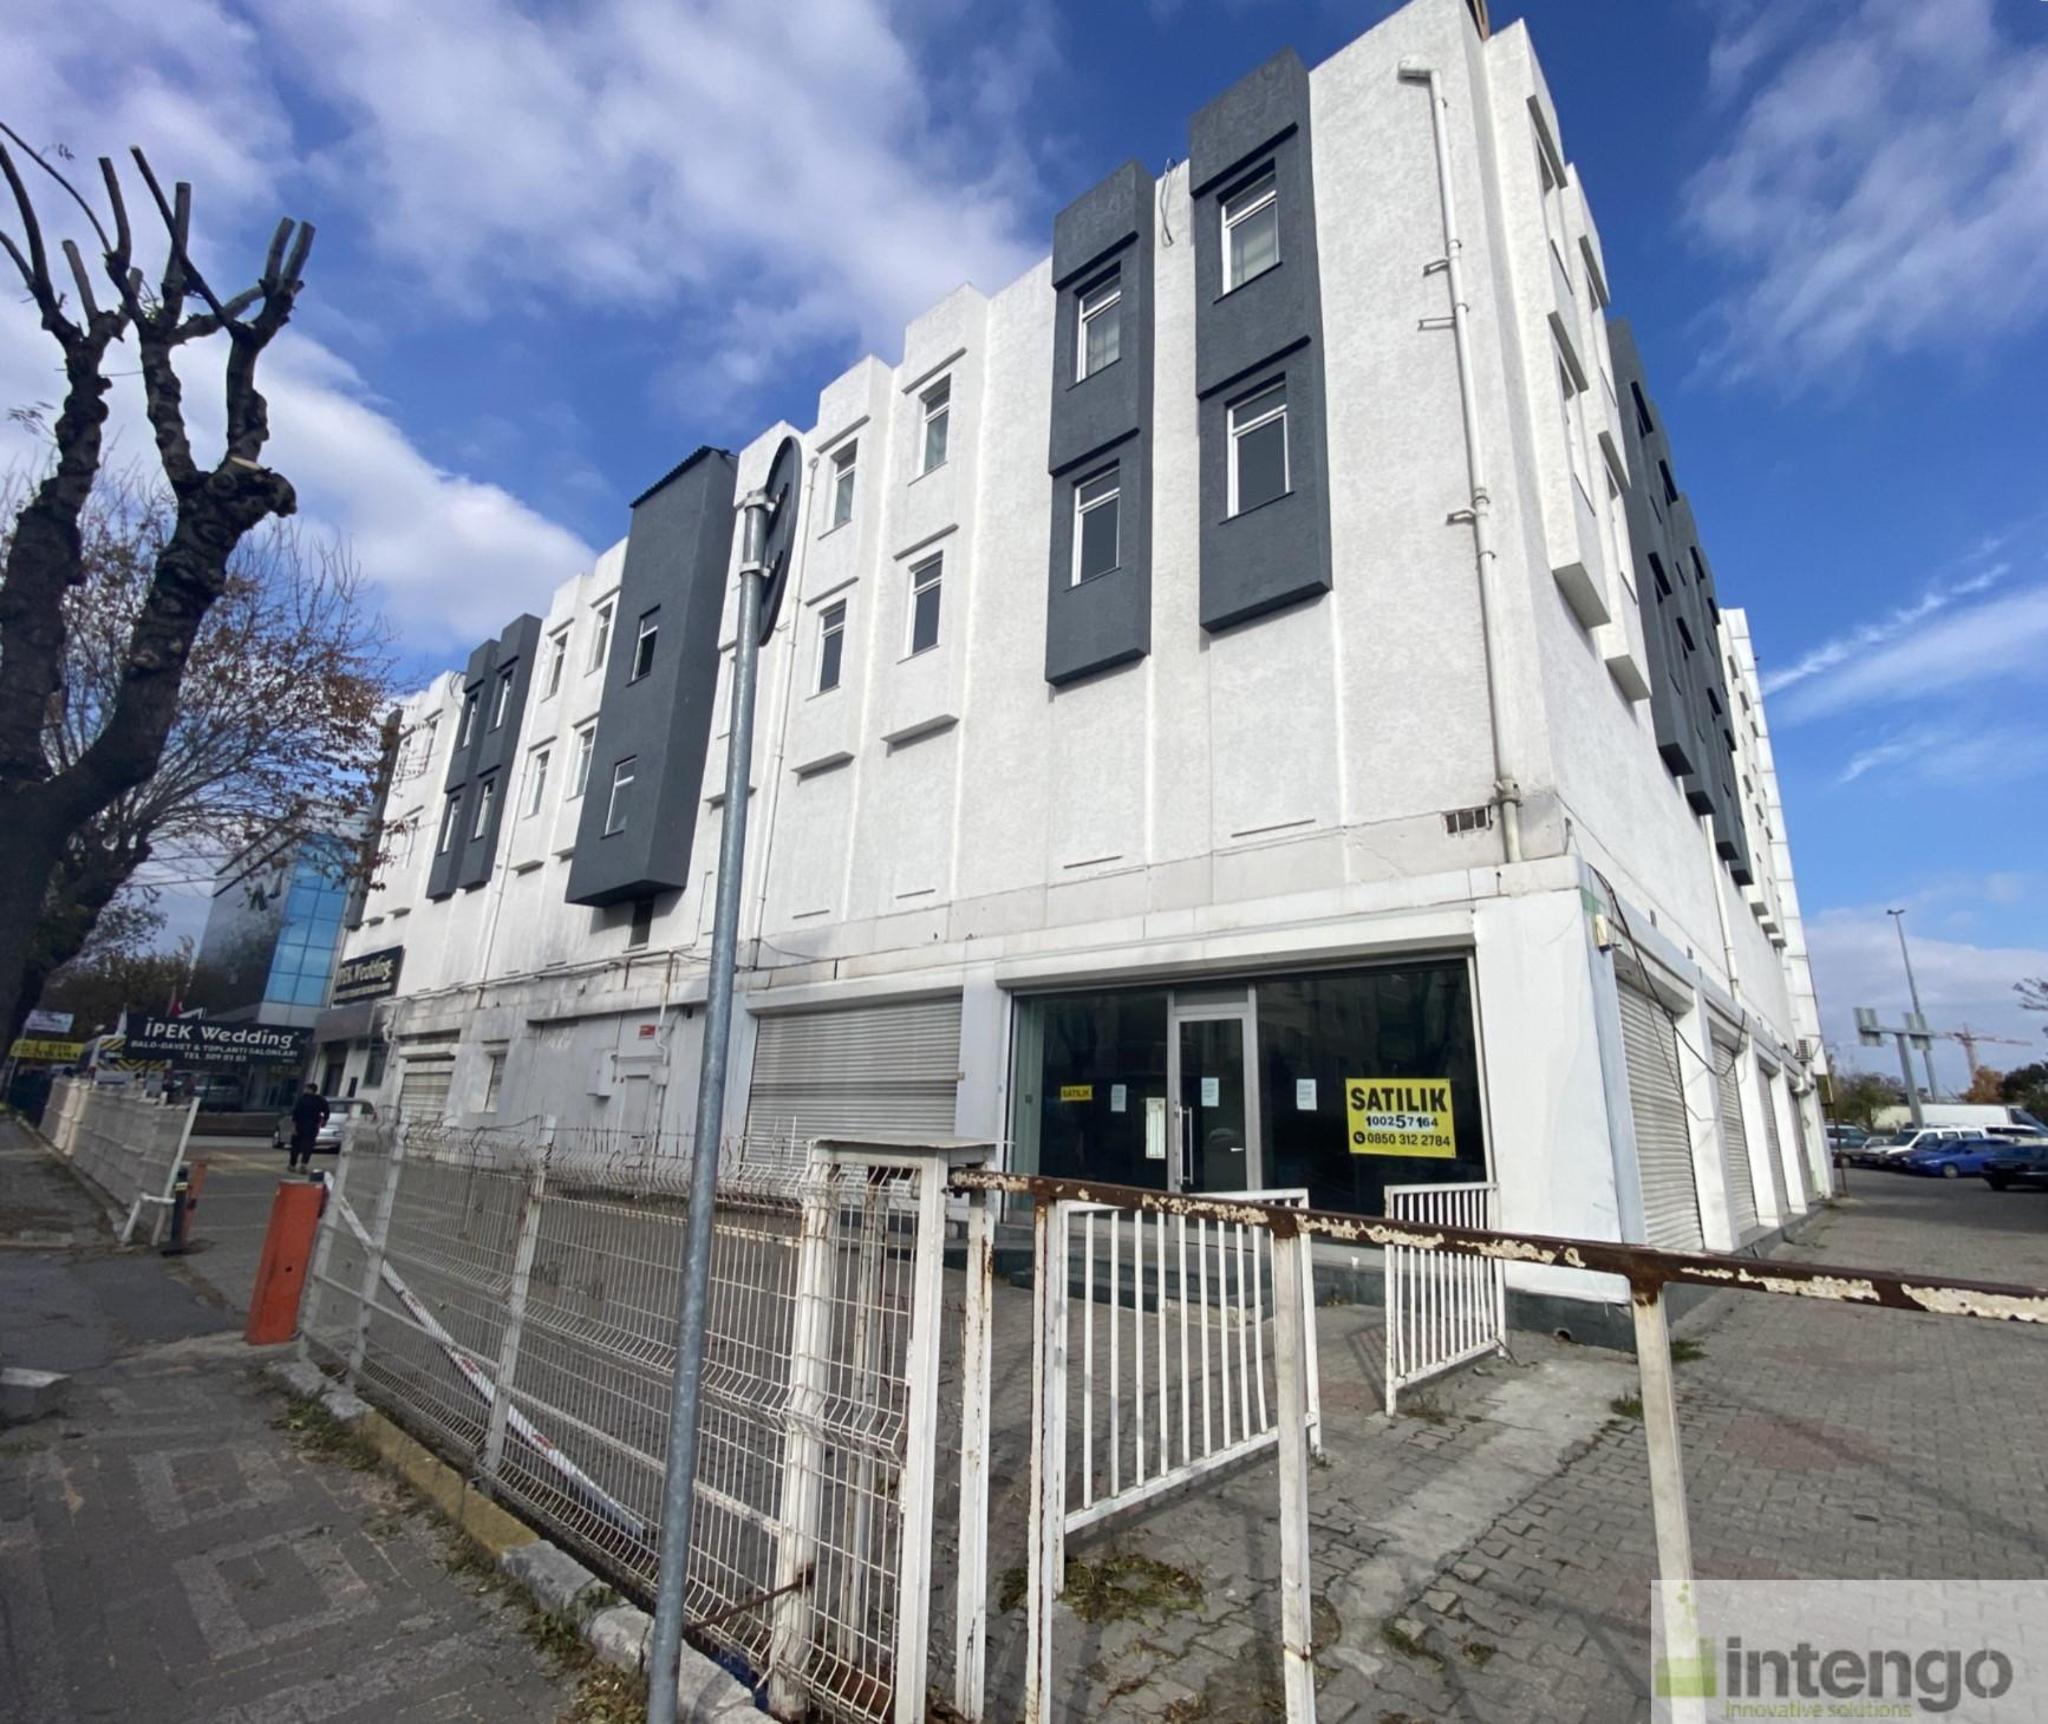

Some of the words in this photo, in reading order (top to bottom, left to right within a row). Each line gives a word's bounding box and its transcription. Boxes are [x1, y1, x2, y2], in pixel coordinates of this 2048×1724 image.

[144, 1016, 193, 1039] İPEK
[201, 1026, 294, 1049] Wedding
[1350, 1087, 1447, 1112] SATILIK
[1366, 1115, 1438, 1128] 100257164
[1367, 1133, 1396, 1144] 0850
[1399, 1134, 1418, 1145] 312
[1421, 1135, 1451, 1146] 2784
